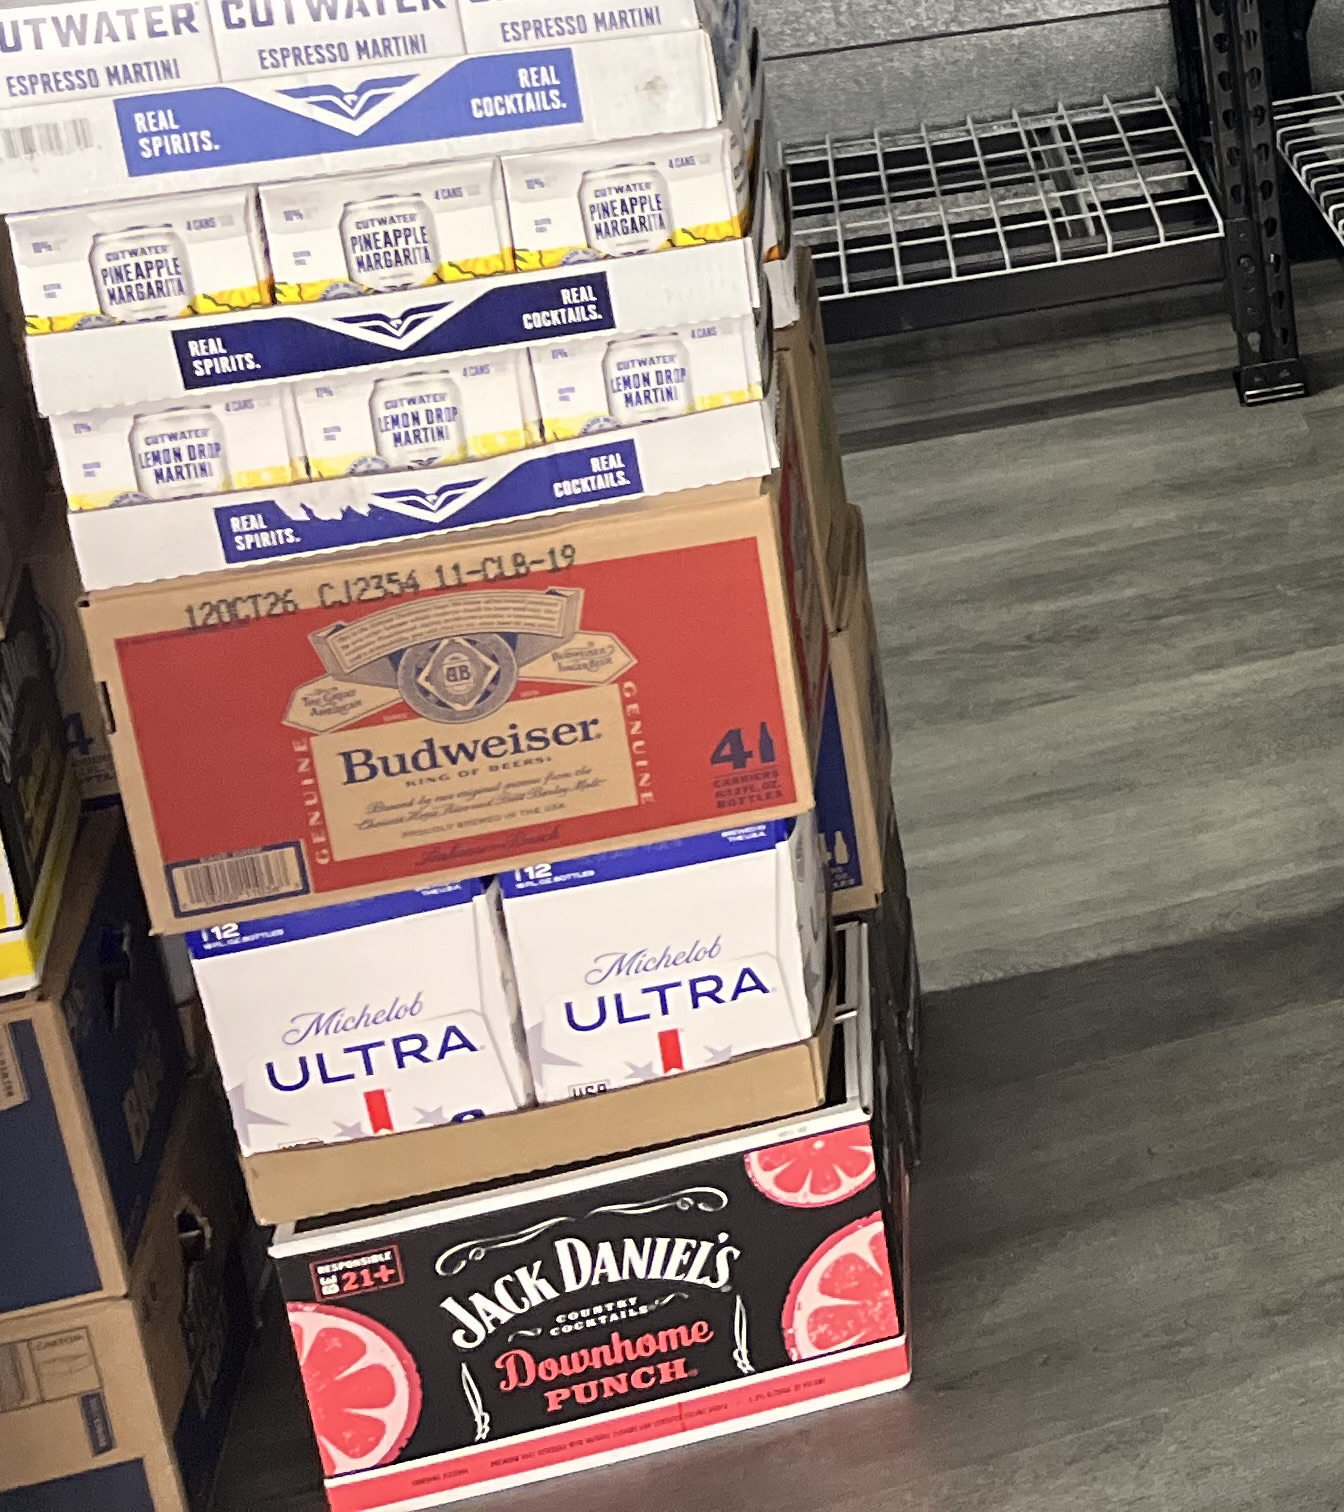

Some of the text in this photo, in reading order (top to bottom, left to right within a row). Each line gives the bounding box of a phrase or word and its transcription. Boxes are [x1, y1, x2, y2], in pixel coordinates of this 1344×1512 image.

[0, 2, 201, 54] UTWATER
[500, 4, 663, 44] ESPRESSO MARTINI
[258, 31, 429, 70] ESPRESSO MARTINI
[6, 57, 182, 99] ESPRESSO MARTINI
[518, 64, 561, 89] REAL
[470, 89, 568, 119] COCKTAILS.
[135, 108, 181, 135] REAL
[139, 129, 222, 159] SPIRITS.
[593, 181, 654, 200] CUTWATER
[355, 213, 418, 231] CUTWATER
[588, 193, 663, 223] PINEAPPLE
[350, 225, 430, 255] PINEAPPLE
[593, 213, 667, 242] MARGARITA
[104, 244, 170, 264] CUTWATER
[355, 245, 434, 274] MARGARITA
[101, 257, 183, 288] PINEAPPLE
[106, 277, 185, 307] MARGARITA
[560, 285, 598, 305] REAL
[522, 303, 604, 331] COCKTAILS.
[187, 336, 228, 358] REAL
[192, 352, 262, 378] SPIRITS.
[616, 353, 679, 372] CUTWATER
[611, 367, 687, 395] LEMON DROP
[384, 392, 448, 411] CUTWATER
[624, 385, 680, 409] MARTINI
[377, 406, 459, 434] LEMON DROP
[144, 428, 211, 447] CUTWATER
[393, 425, 450, 448] MARTINI
[139, 441, 223, 470] LEMON DROP
[590, 453, 626, 474] REAL
[154, 461, 214, 486] MARTINI
[552, 470, 631, 499] COCKTAILS.
[229, 514, 268, 535] REAL
[234, 529, 303, 552] SPIRITS.
[338, 717, 600, 787] Budweiser
[623, 681, 656, 805] GENUINE
[708, 727, 755, 770] 4
[405, 773, 451, 789] KING
[457, 767, 480, 780] OF
[291, 734, 331, 866] GENUINE
[716, 791, 784, 810] BOTTLES
[524, 863, 554, 881] 12
[211, 922, 241, 942] 12
[584, 934, 722, 986] Michelob
[564, 966, 770, 1032] ULTRA
[281, 990, 424, 1046] Michelob
[264, 1025, 480, 1092] ULTRA
[316, 1250, 393, 1275] RESPONSIBLE
[341, 1264, 397, 1292] 21+
[439, 1260, 561, 1350] JACK
[554, 1296, 638, 1325] COUNTRY
[549, 1306, 650, 1339] COCKTAILS
[494, 1319, 715, 1394] Downhome
[545, 1357, 690, 1414] PUNCH
